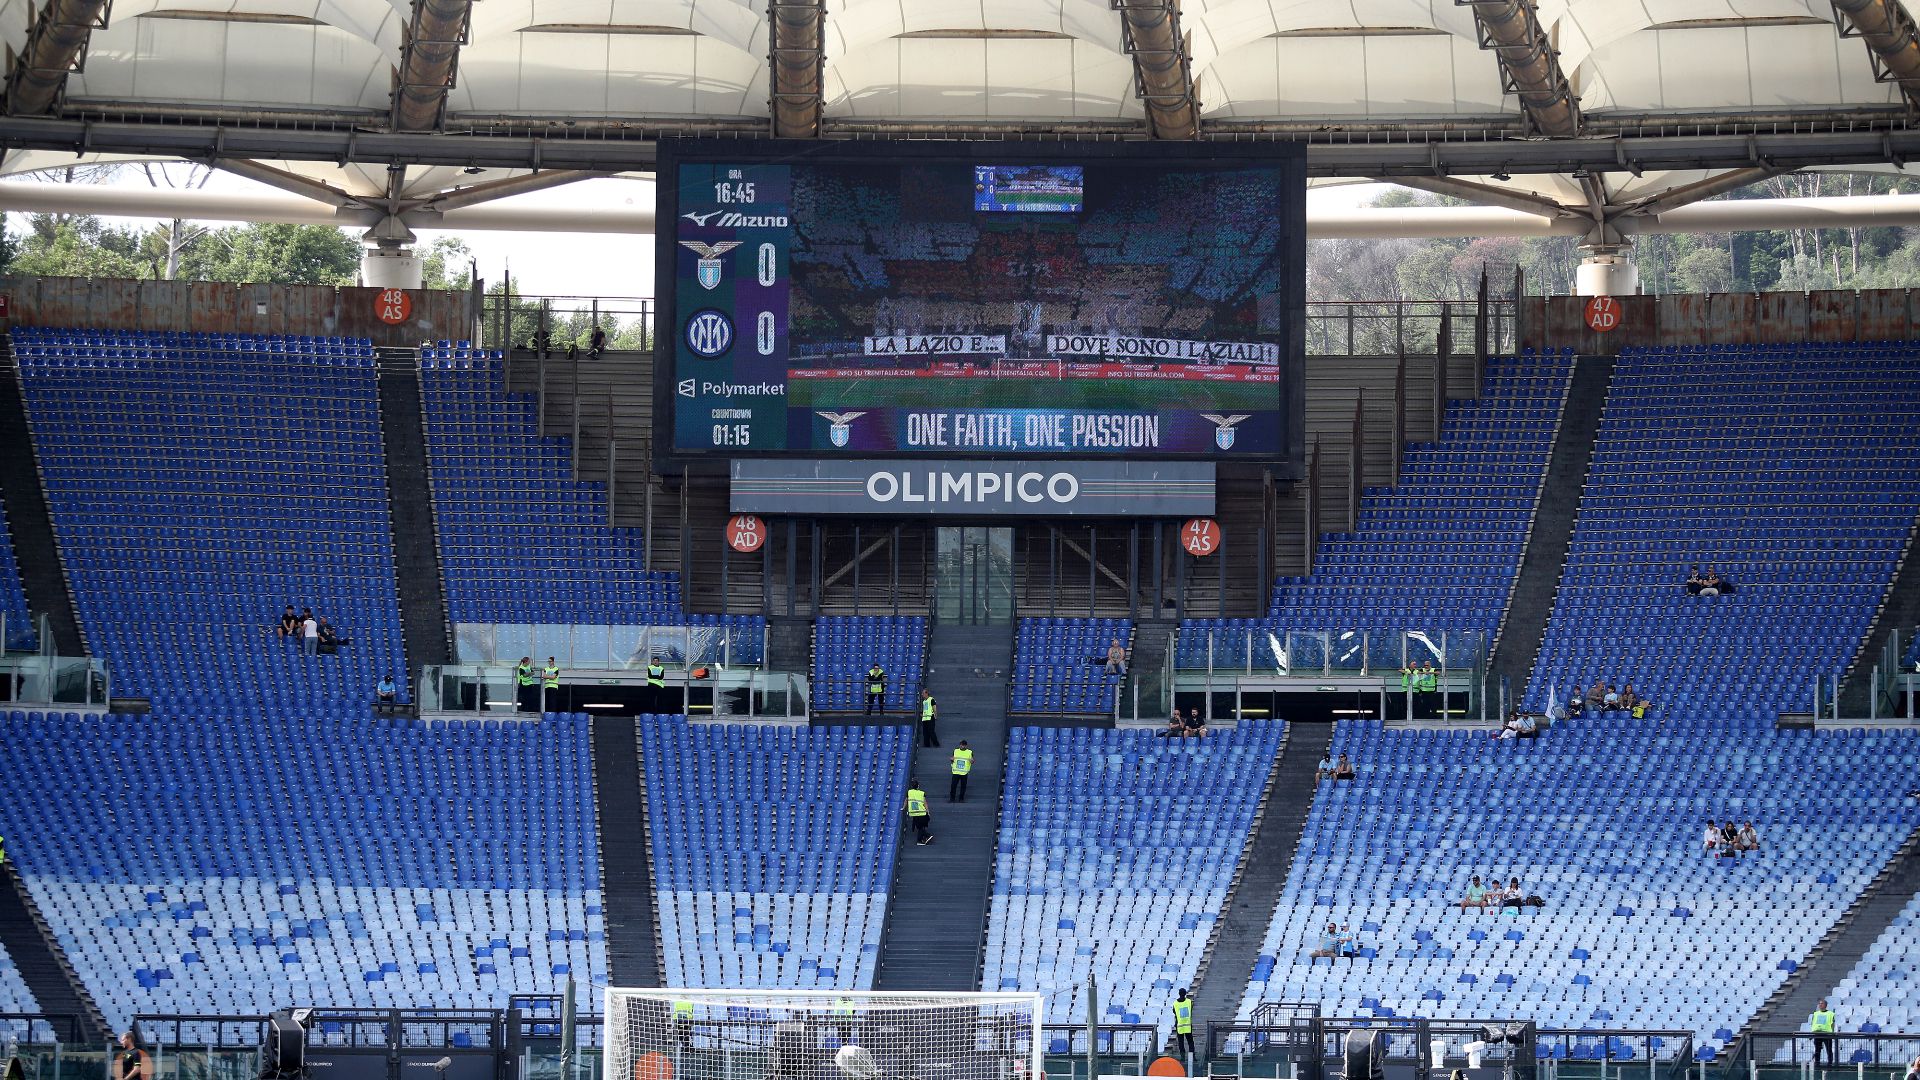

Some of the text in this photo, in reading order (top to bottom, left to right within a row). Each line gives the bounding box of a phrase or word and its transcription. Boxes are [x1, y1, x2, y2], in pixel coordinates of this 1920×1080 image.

[728, 169, 743, 179] ORA
[714, 182, 755, 203] 16:45
[758, 242, 776, 287] 0
[383, 290, 402, 305] 48
[1593, 297, 1612, 312] 47
[382, 305, 403, 320] AS
[1591, 313, 1614, 327] AD
[757, 310, 775, 355] 0
[872, 337, 899, 353] LA
[905, 336, 964, 353] LAZIO
[1054, 336, 1110, 353] DOVE
[1116, 337, 1170, 355] SONO
[1176, 340, 1183, 356] I
[702, 381, 785, 398] Polymarket
[711, 408, 752, 419] COUNTDOWN
[712, 424, 750, 446] 01:15
[907, 413, 1159, 450] ONE FAITH, ONE PASSION
[866, 471, 1079, 503] OLIMPICO
[735, 515, 756, 530] 48
[1190, 519, 1210, 535] 47
[733, 531, 758, 547] AD
[1189, 535, 1211, 551] AS
